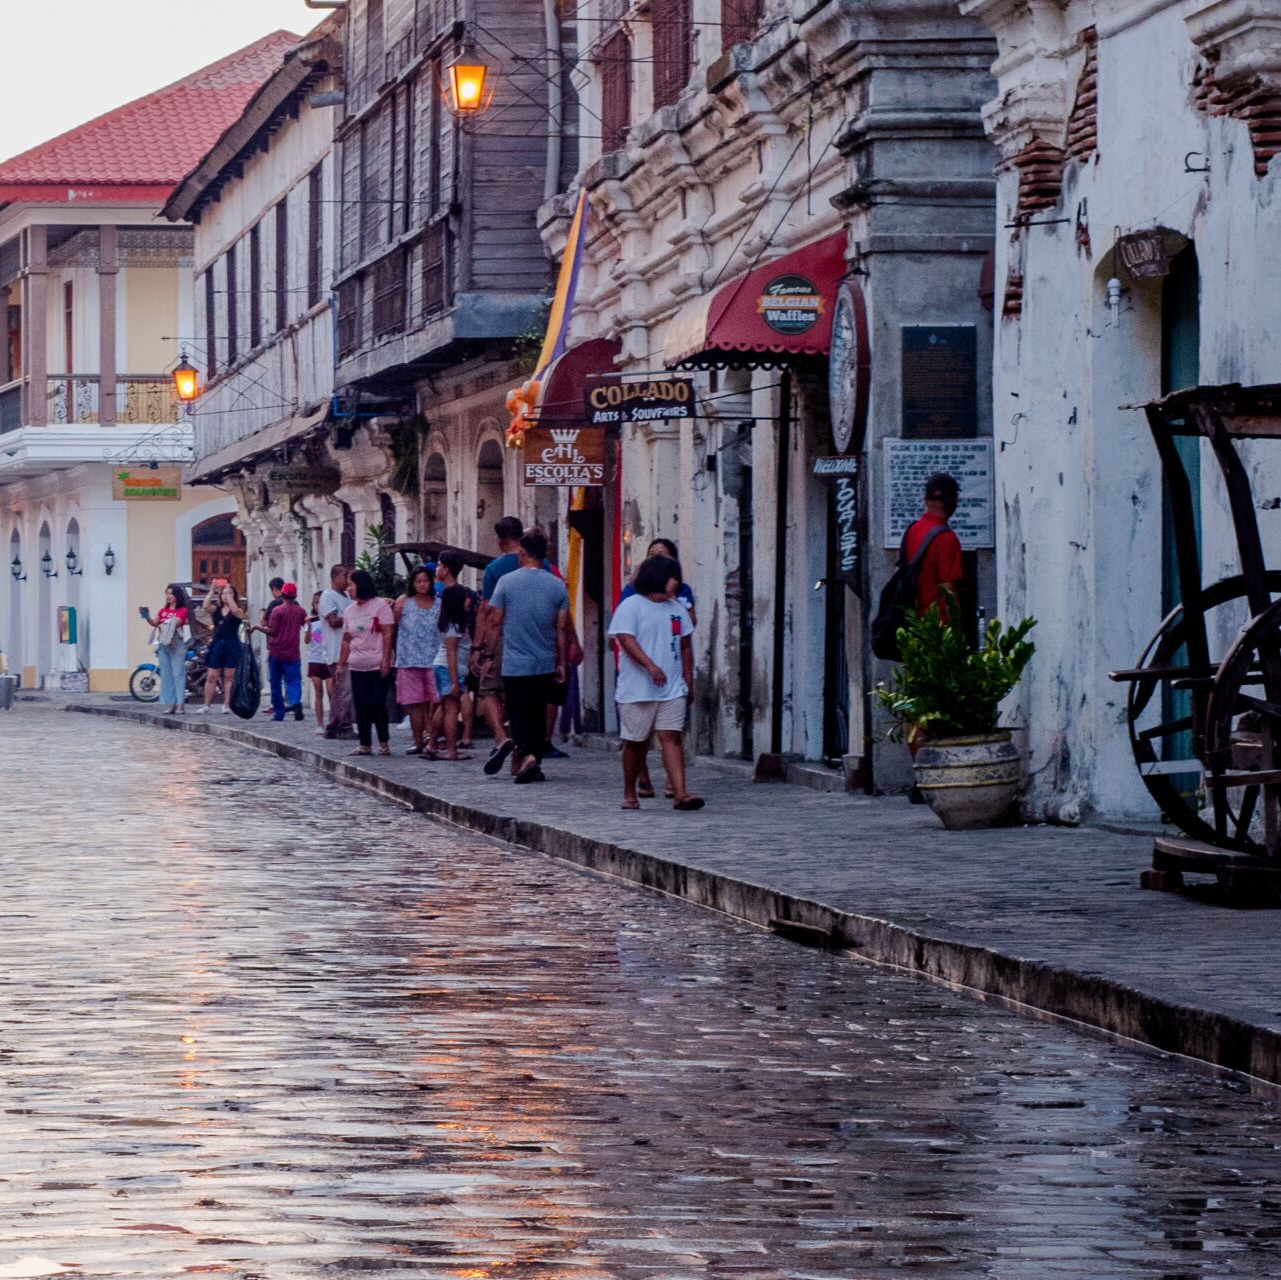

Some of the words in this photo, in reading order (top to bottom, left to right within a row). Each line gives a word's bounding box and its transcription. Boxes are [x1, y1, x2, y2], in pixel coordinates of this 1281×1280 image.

[762, 297, 820, 308] BELGIAN
[765, 309, 816, 322] Waffles
[589, 381, 689, 409] COLLADO
[592, 410, 620, 423] ARTS
[524, 465, 604, 479] ESCOLTA'S
